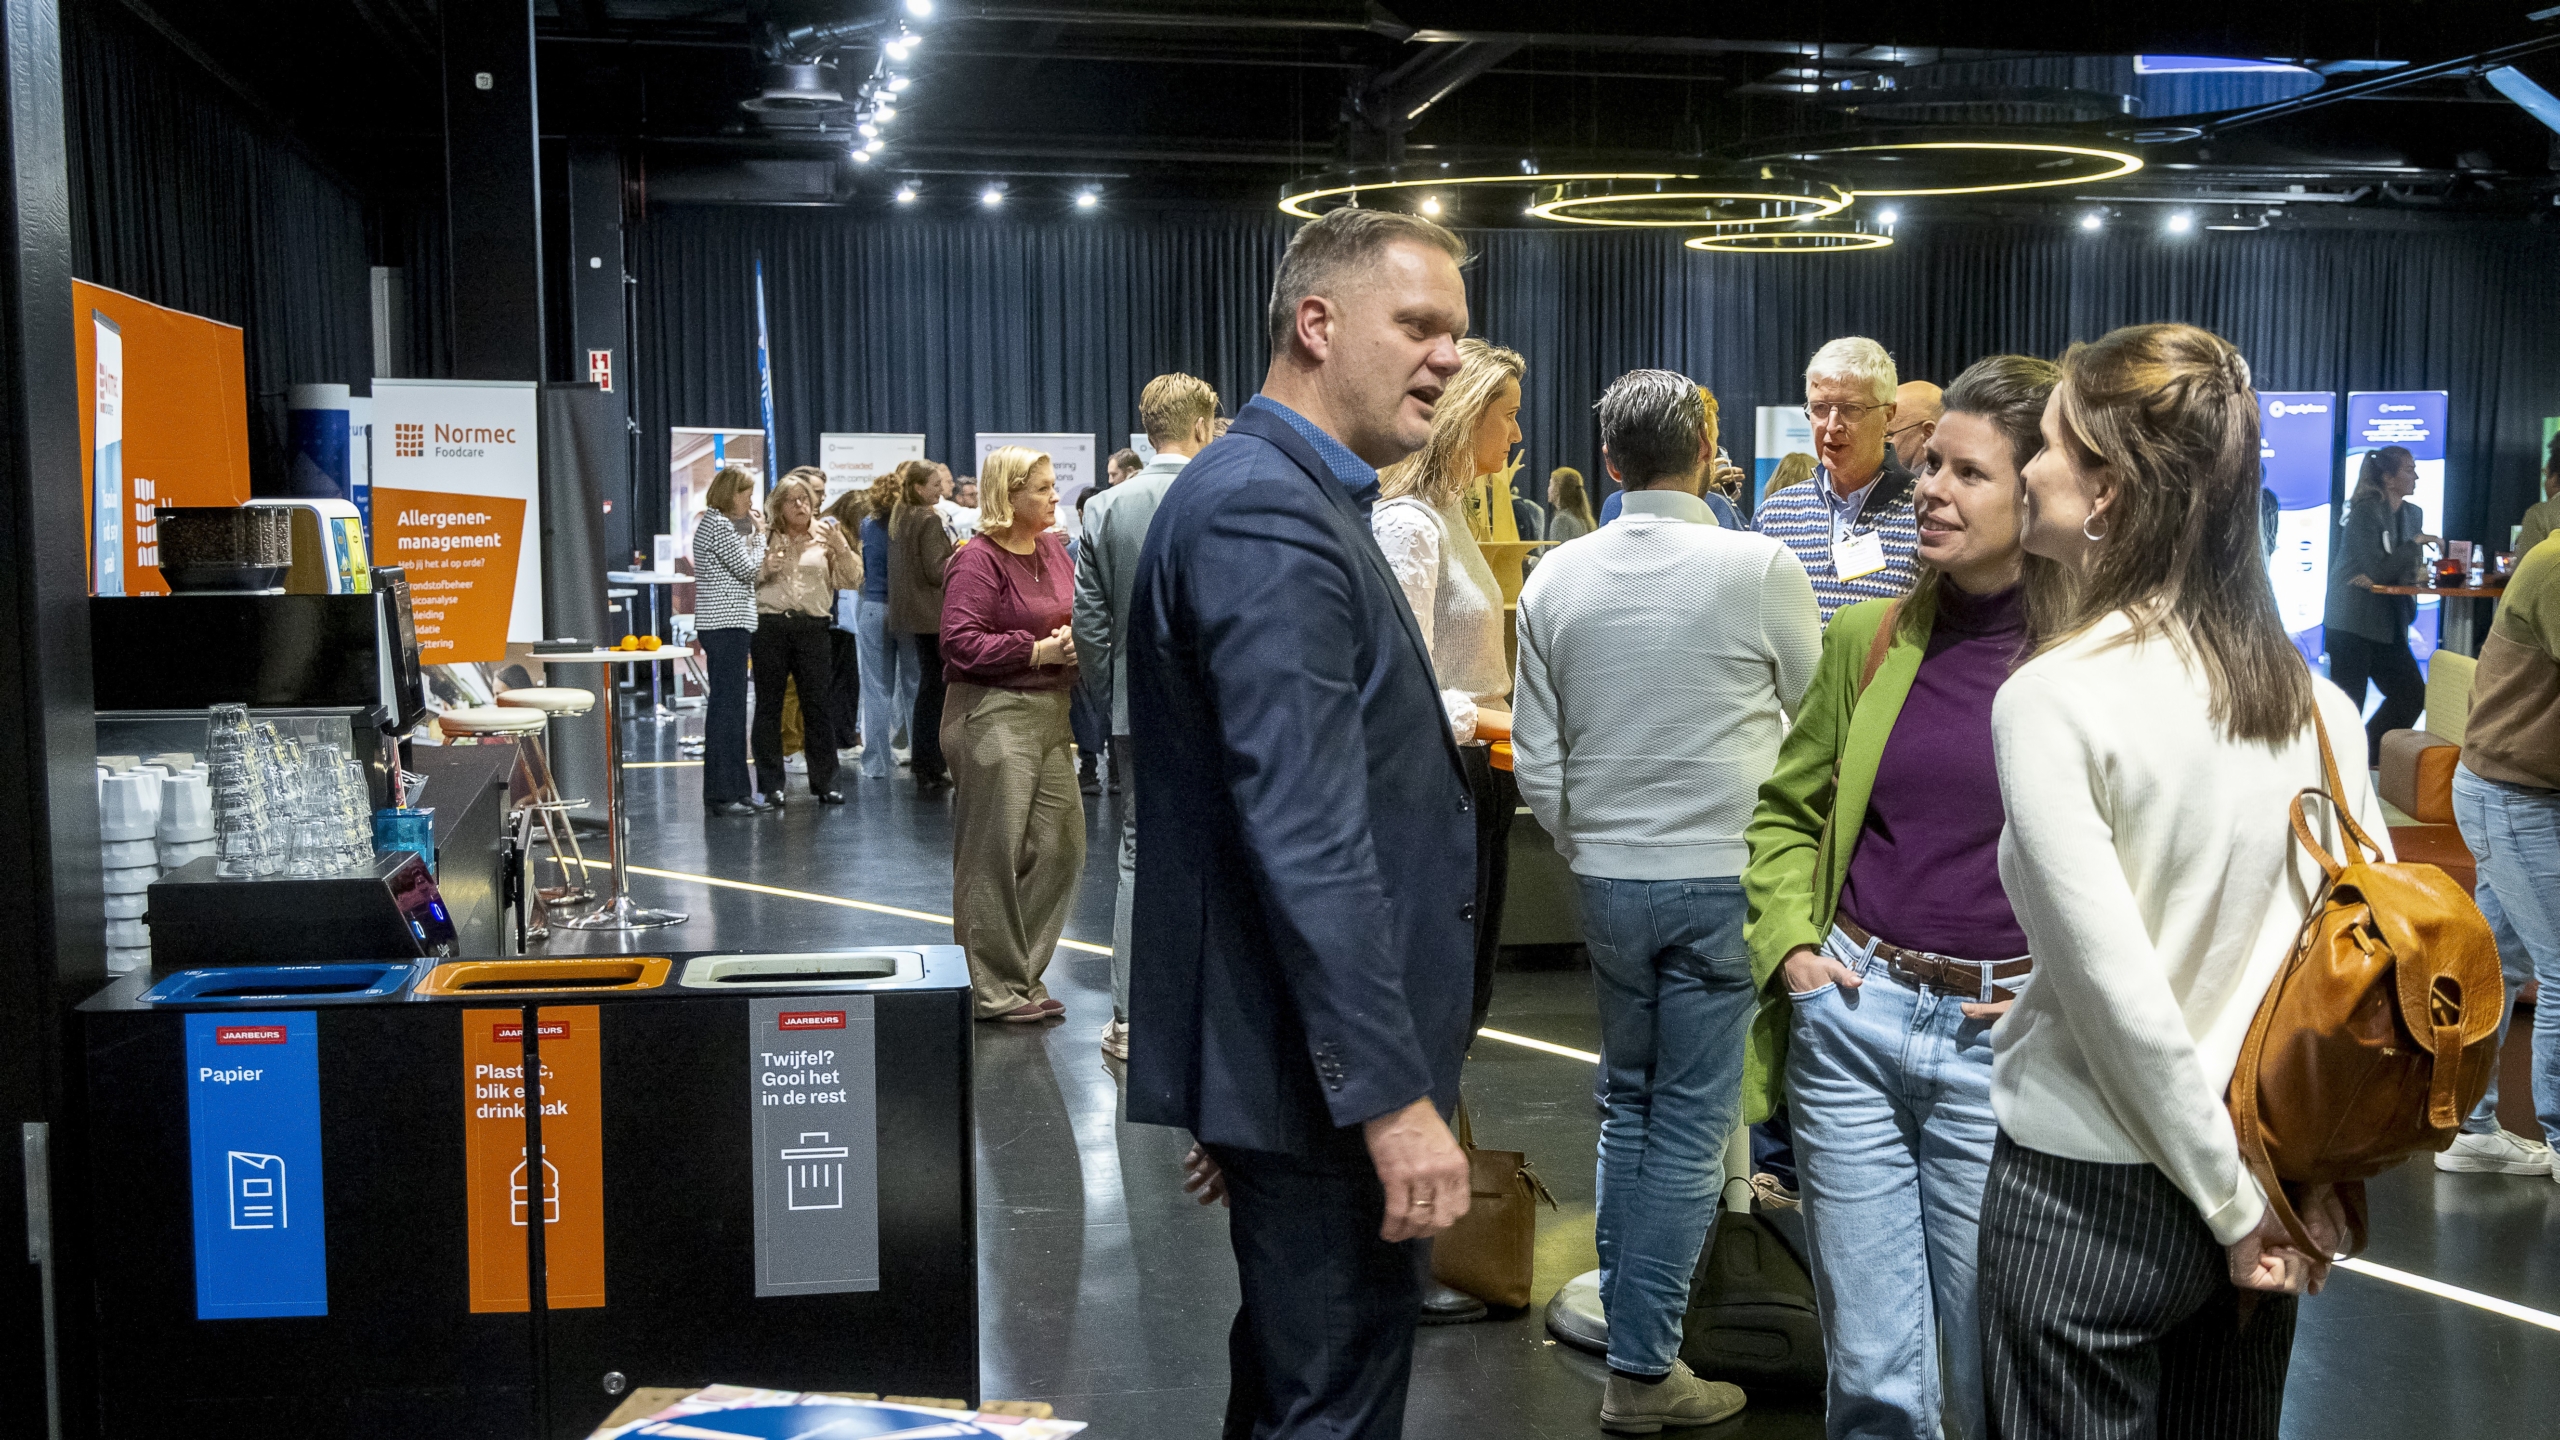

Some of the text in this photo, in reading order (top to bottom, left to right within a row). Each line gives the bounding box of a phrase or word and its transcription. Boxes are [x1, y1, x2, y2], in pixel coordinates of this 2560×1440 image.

[434, 423, 516, 444] Normec
[435, 447, 484, 458] Foodcare
[397, 509, 492, 529] Allergenen-
[398, 532, 502, 552] management
[415, 558, 424, 570] jij
[424, 558, 439, 569] het
[440, 558, 449, 569] al
[450, 559, 461, 570] op
[462, 557, 486, 569] orde?
[408, 579, 474, 591] rondstofbeheer
[411, 595, 459, 606] sicoanalyse
[415, 625, 441, 636] lidatie
[784, 1016, 840, 1025] JAARBEURS
[222, 1030, 280, 1040] JAARBEURS
[498, 1026, 563, 1038] JAAREURS
[760, 1050, 835, 1070] Twijfel?
[200, 1066, 263, 1085] Papier
[475, 1062, 554, 1080] Plastc,
[762, 1069, 840, 1087] Gooi het
[475, 1083, 510, 1099] blik
[762, 1088, 847, 1106] in de rest
